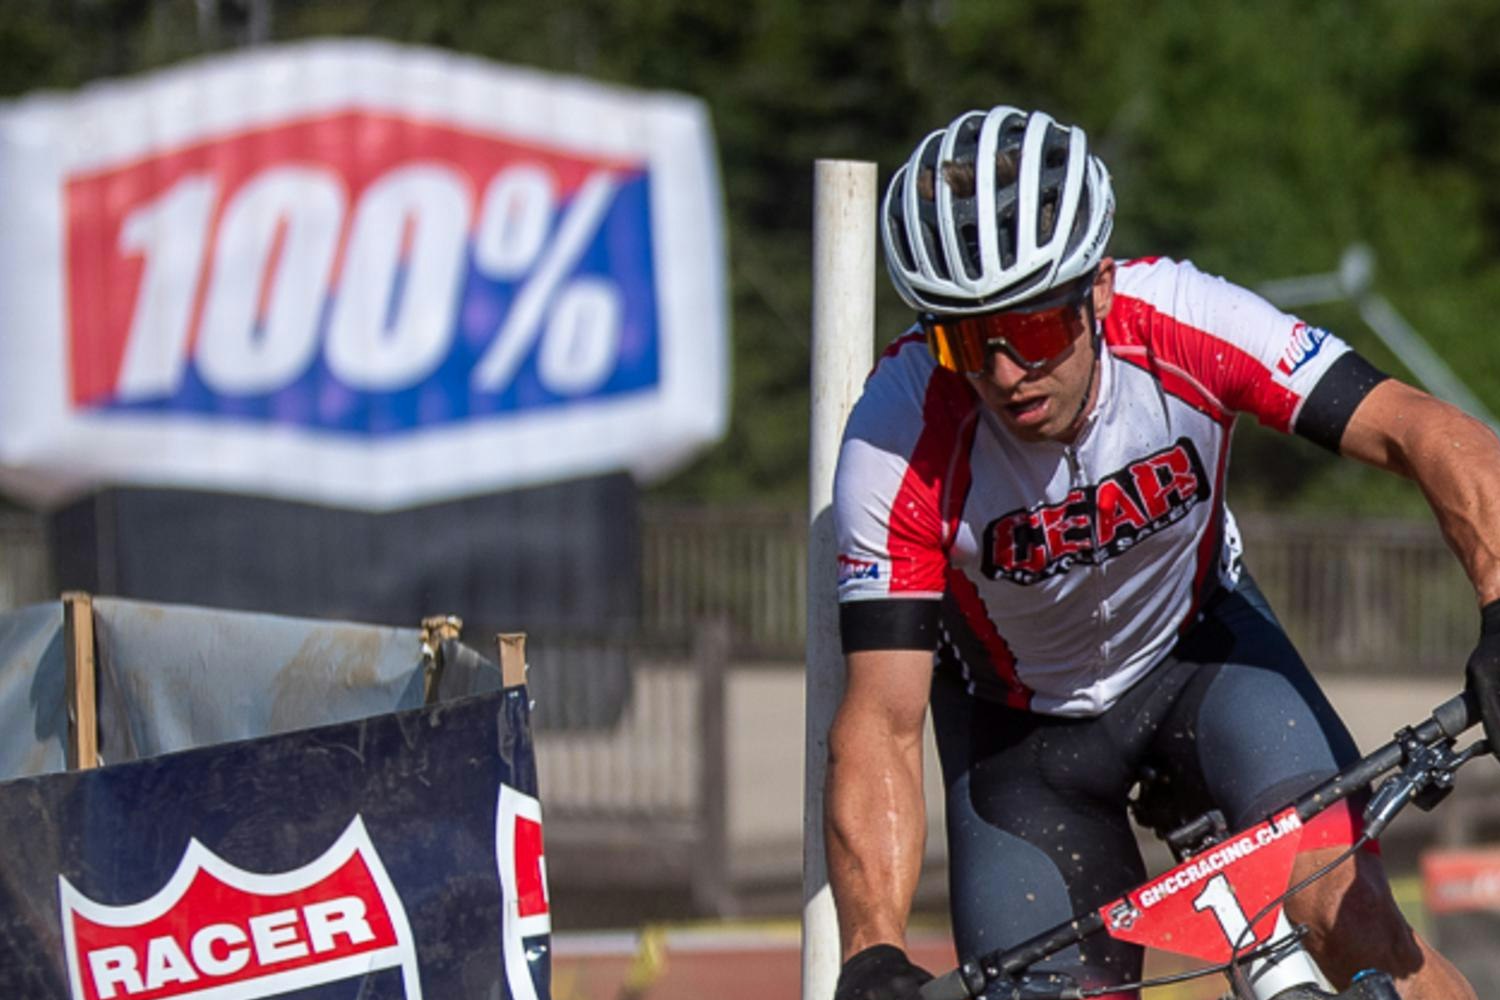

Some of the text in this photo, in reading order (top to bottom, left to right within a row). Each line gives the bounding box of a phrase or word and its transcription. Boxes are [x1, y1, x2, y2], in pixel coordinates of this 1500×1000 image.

[113, 160, 622, 397] 100%
[87, 894, 378, 1000] RACER
[1192, 871, 1258, 951] 1
